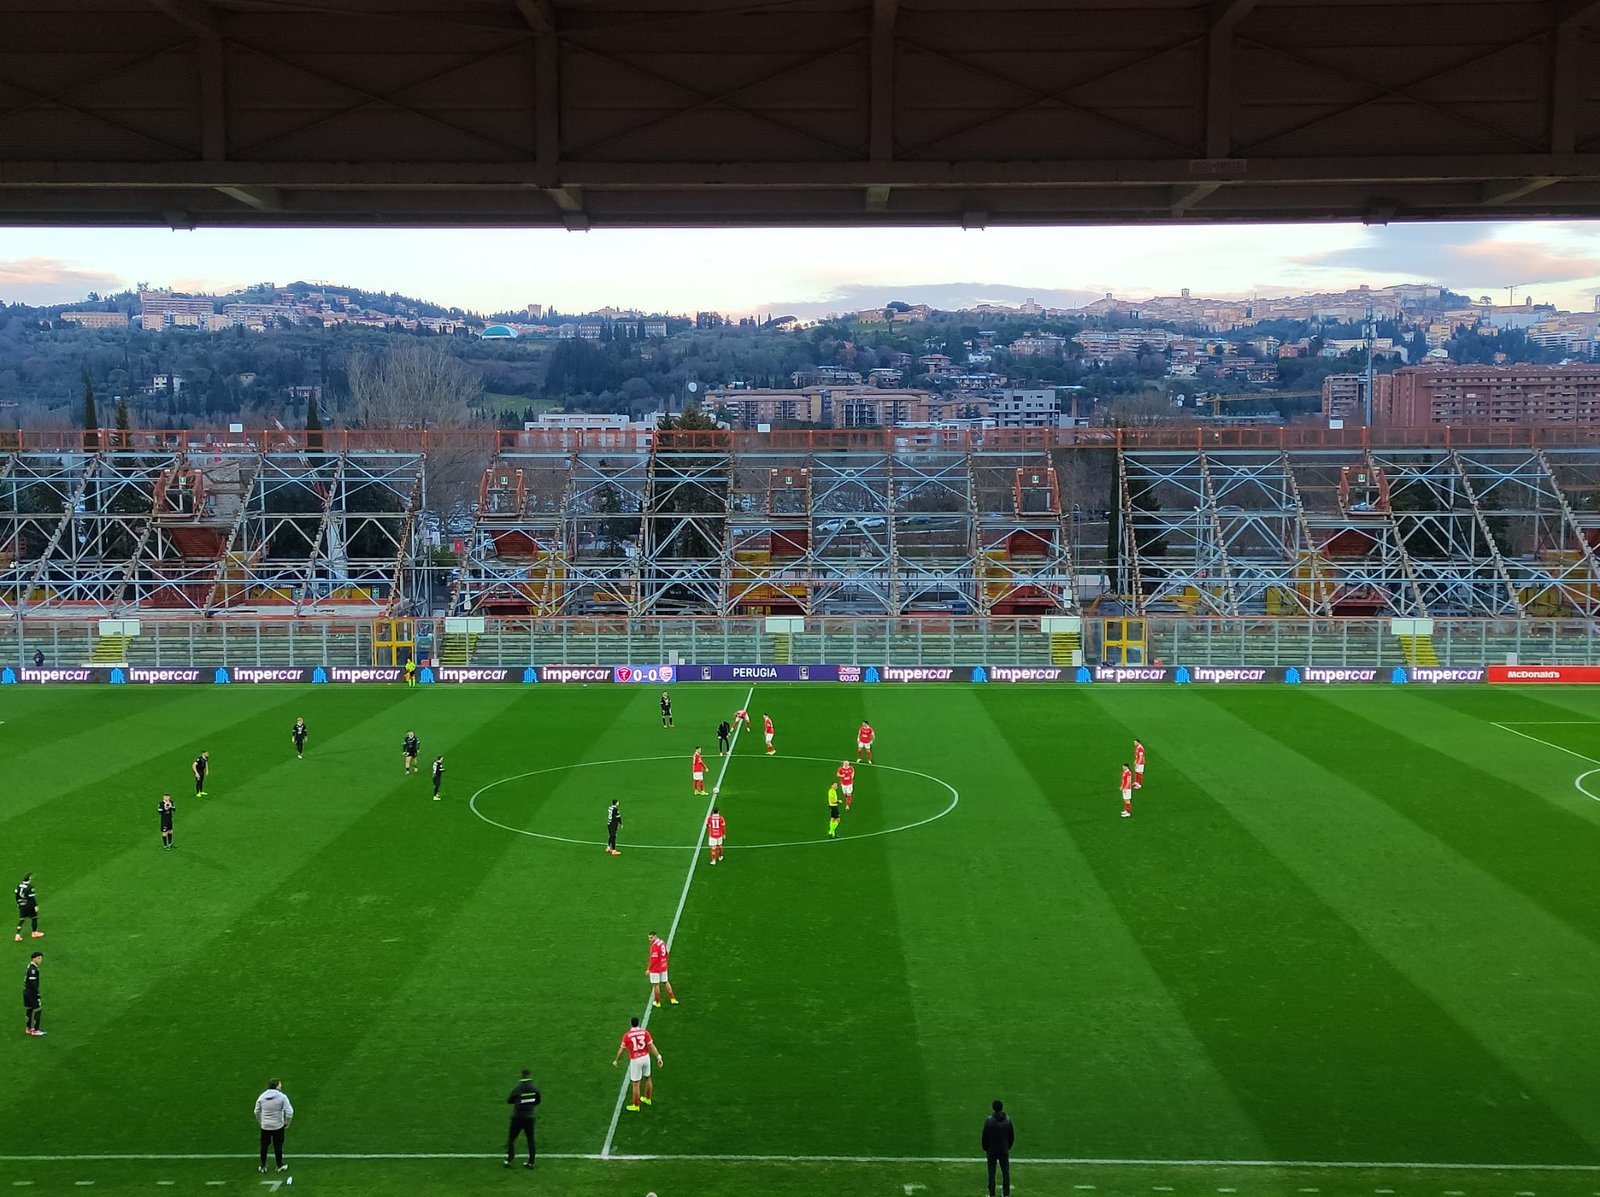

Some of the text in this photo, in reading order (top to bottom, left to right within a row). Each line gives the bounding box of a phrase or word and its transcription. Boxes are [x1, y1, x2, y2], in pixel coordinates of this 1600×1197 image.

[21, 667, 91, 683] impercar
[129, 667, 199, 683] impercar
[234, 667, 303, 683] impercar
[331, 667, 400, 683] impercar
[439, 667, 507, 683] impercar
[543, 667, 610, 683] impercar
[633, 669, 657, 681] 0-0
[733, 667, 778, 678] PERUGIA
[840, 674, 860, 682] 00:00
[884, 666, 953, 683] impercar
[991, 666, 1061, 683] impercar
[1194, 667, 1265, 683] impercar
[1305, 667, 1376, 683] impercar
[1412, 667, 1484, 683] impercar
[1507, 670, 1560, 679] McDonald's
[630, 1035, 646, 1052] 13
